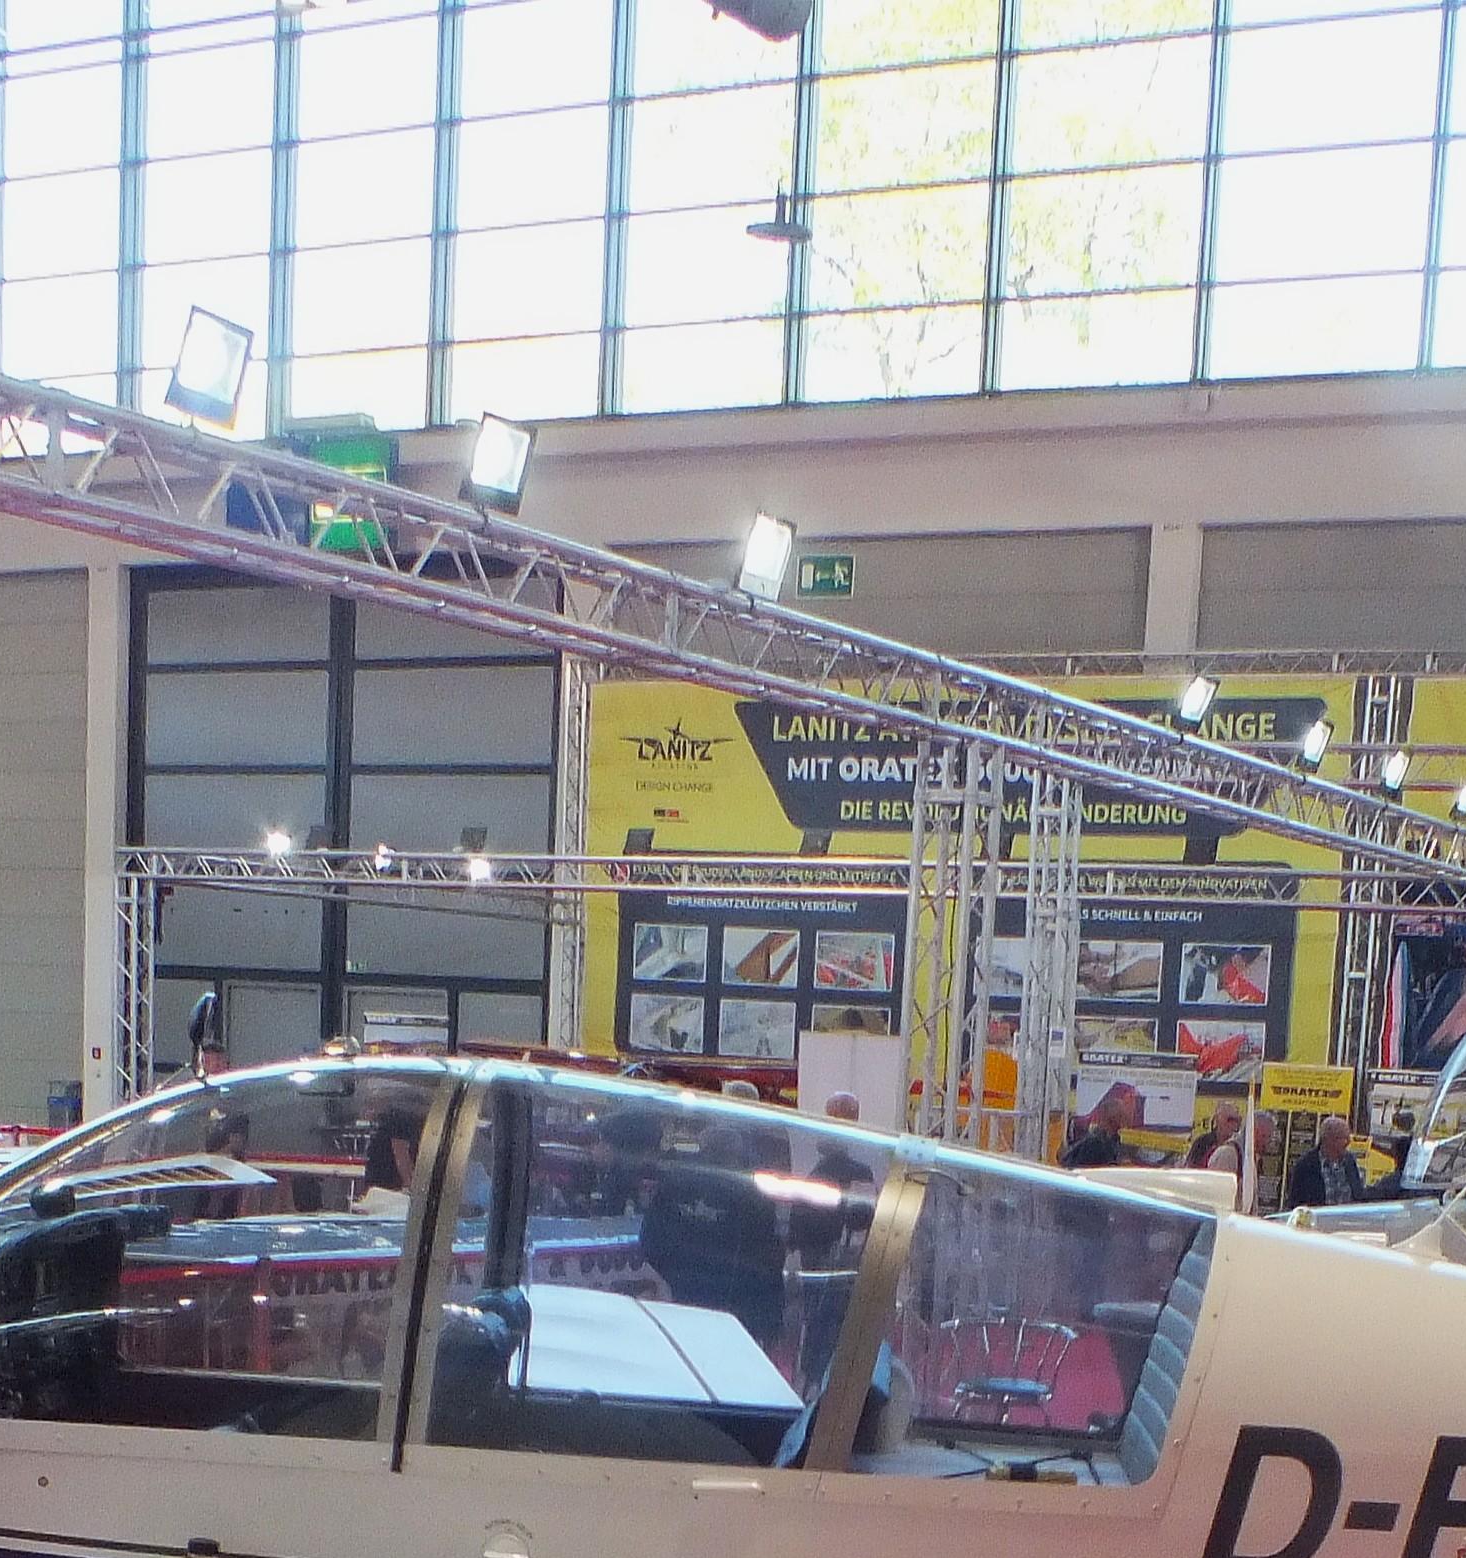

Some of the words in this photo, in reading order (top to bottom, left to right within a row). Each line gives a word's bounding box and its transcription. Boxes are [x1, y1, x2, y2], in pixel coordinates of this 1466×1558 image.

[637, 736, 713, 761] LANITZ
[787, 757, 830, 782] MIT
[840, 801, 872, 821] DIE
[1071, 803, 1187, 824] NDERUNG
[801, 899, 858, 913] VERSTÄRKT
[1092, 908, 1140, 922] SCHNELL
[1154, 910, 1203, 923] EINFACH
